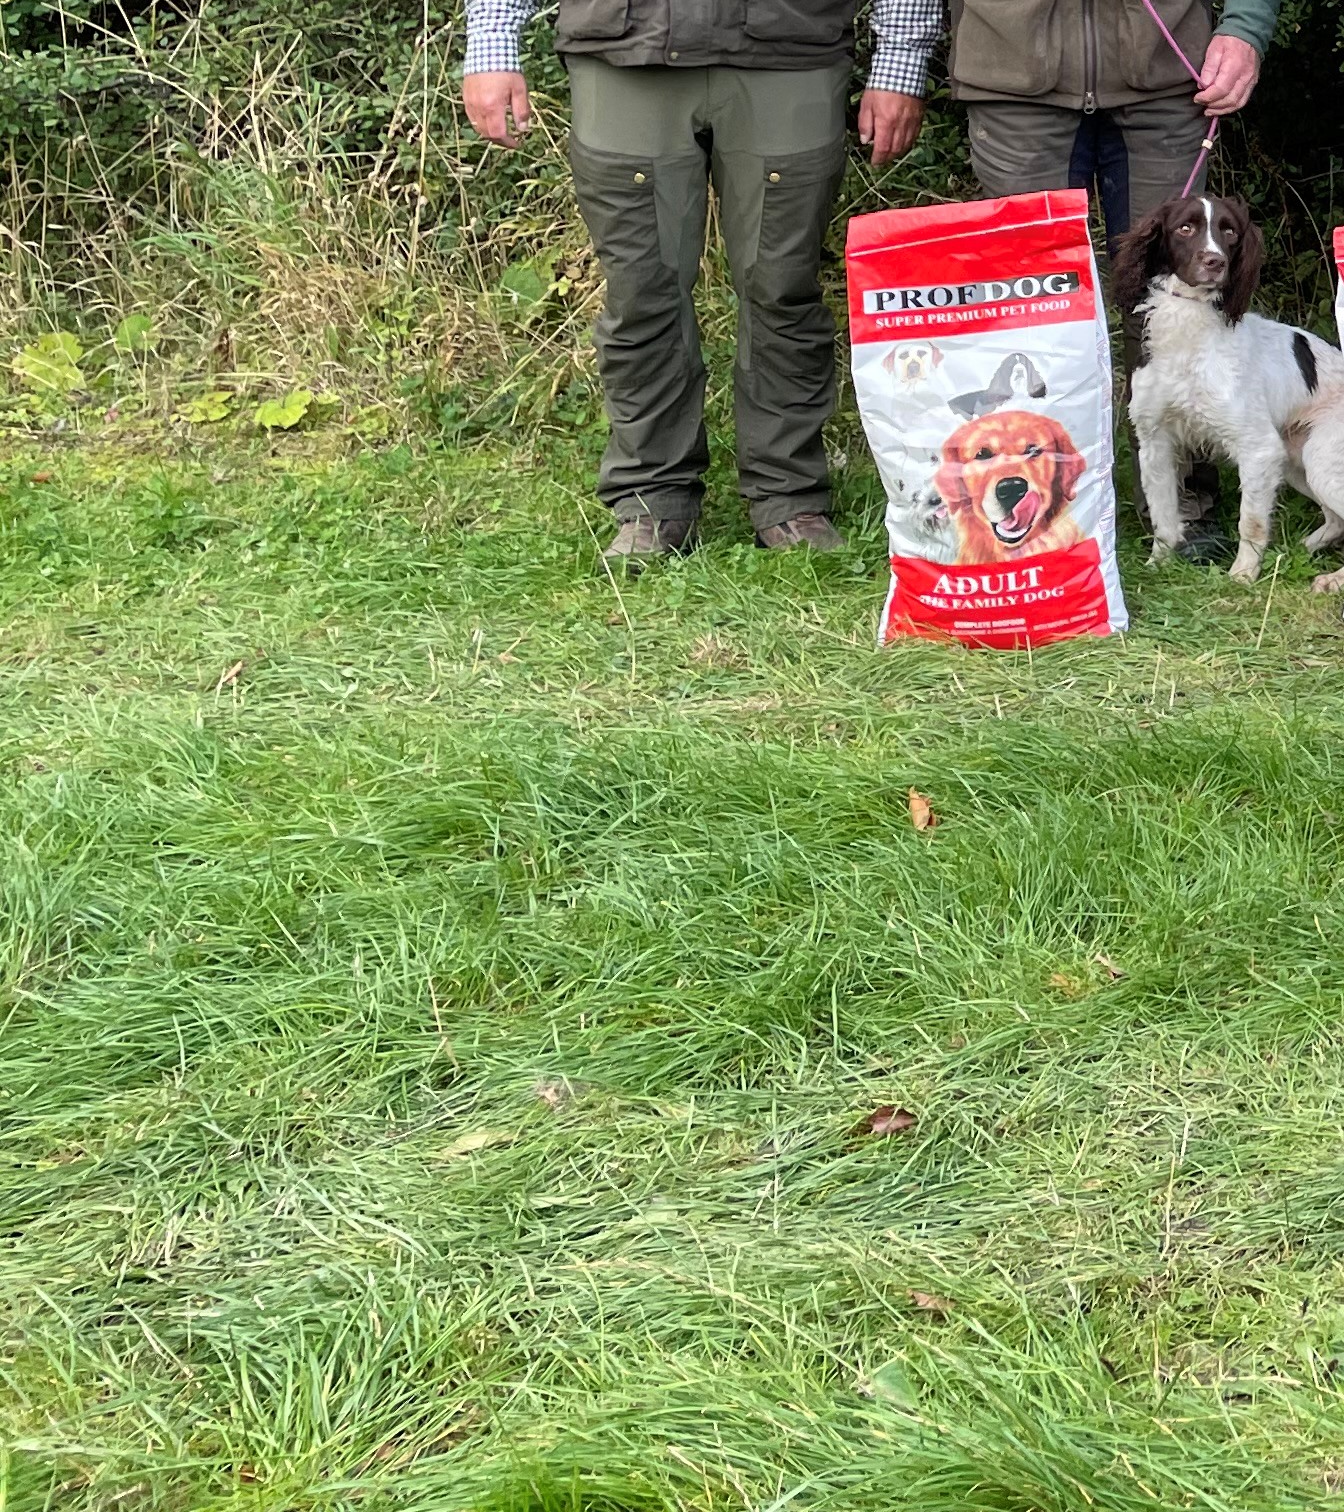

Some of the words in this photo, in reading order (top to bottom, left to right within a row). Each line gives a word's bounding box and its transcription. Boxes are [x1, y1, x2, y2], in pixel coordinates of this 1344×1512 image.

[875, 273, 1072, 311] PROFDOG
[875, 314, 923, 328] SUPER
[927, 308, 998, 324] PREMIUM
[1000, 303, 1026, 316] PET
[1031, 299, 1071, 313] FOOD
[932, 566, 1044, 596] ADULT
[952, 594, 1020, 610] FAMILY
[1023, 585, 1065, 604] DOG
